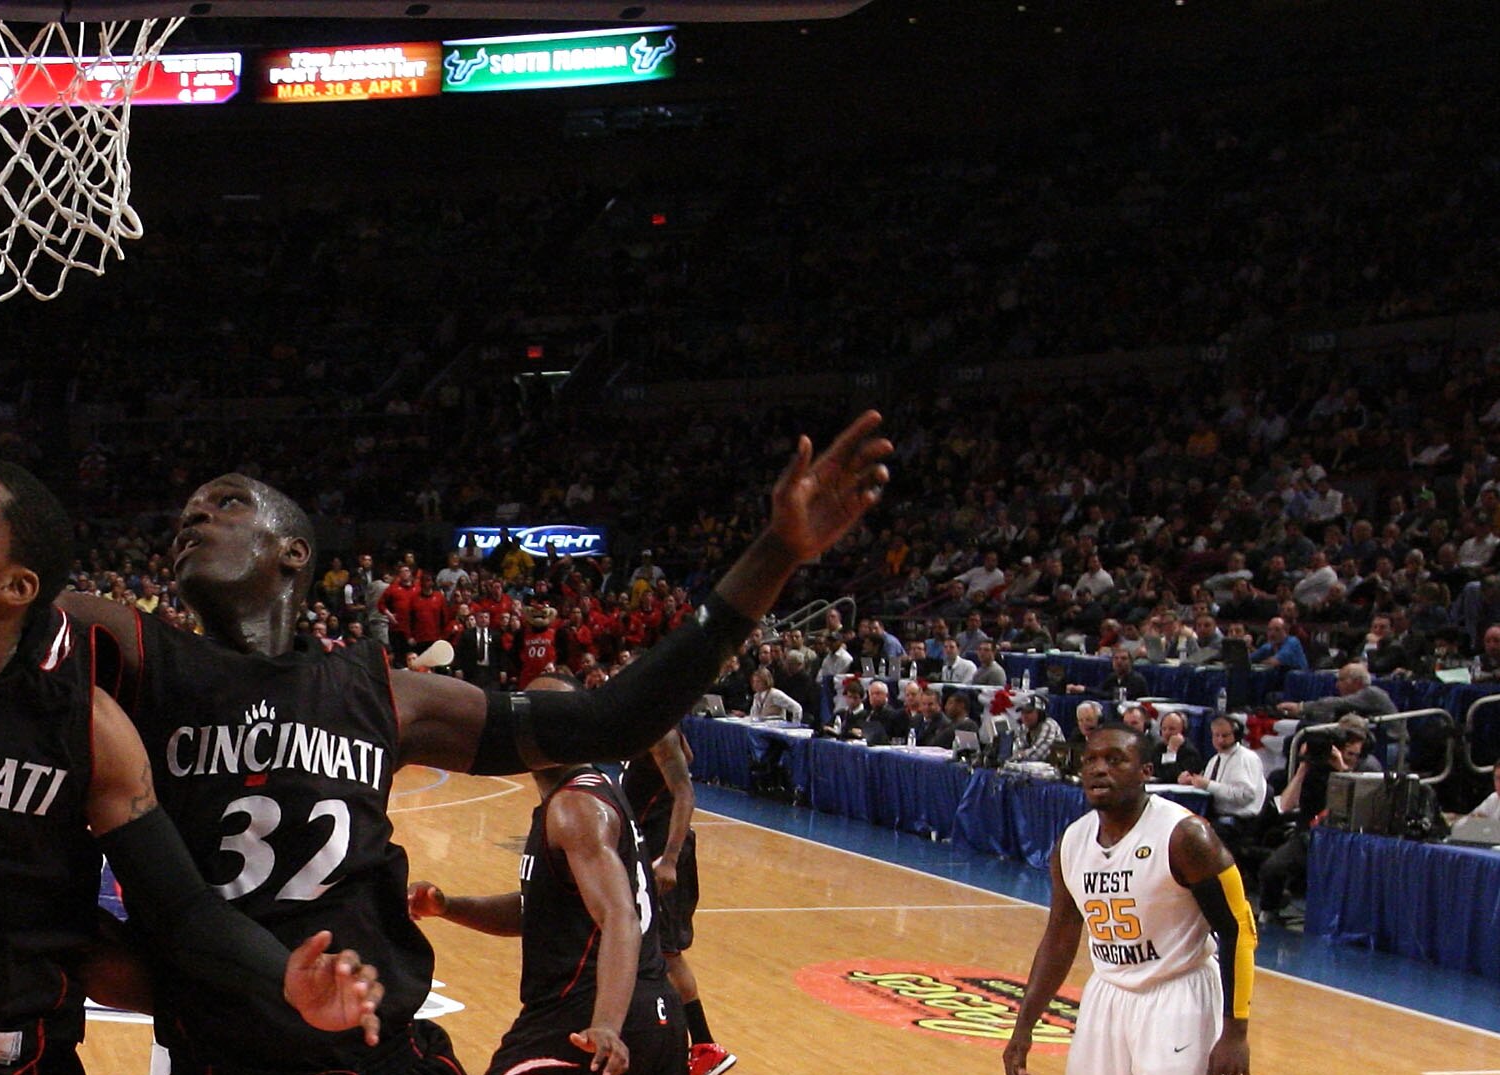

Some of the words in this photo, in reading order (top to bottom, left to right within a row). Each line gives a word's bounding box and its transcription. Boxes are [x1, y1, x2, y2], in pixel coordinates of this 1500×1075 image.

[490, 51, 550, 75] SOUTH
[553, 46, 627, 71] FLORIDA
[270, 68, 318, 83] POST
[277, 84, 320, 98] MAR.
[325, 83, 344, 96] 30
[350, 82, 363, 95] &
[368, 80, 402, 94] APR
[409, 79, 417, 92] 1
[523, 533, 601, 549] LIGHT
[166, 720, 384, 791] CINCINNATI
[209, 794, 351, 901] 32
[1083, 870, 1133, 894] WEST
[1085, 898, 1141, 941] 25
[1092, 940, 1160, 966] VIRGINIA
